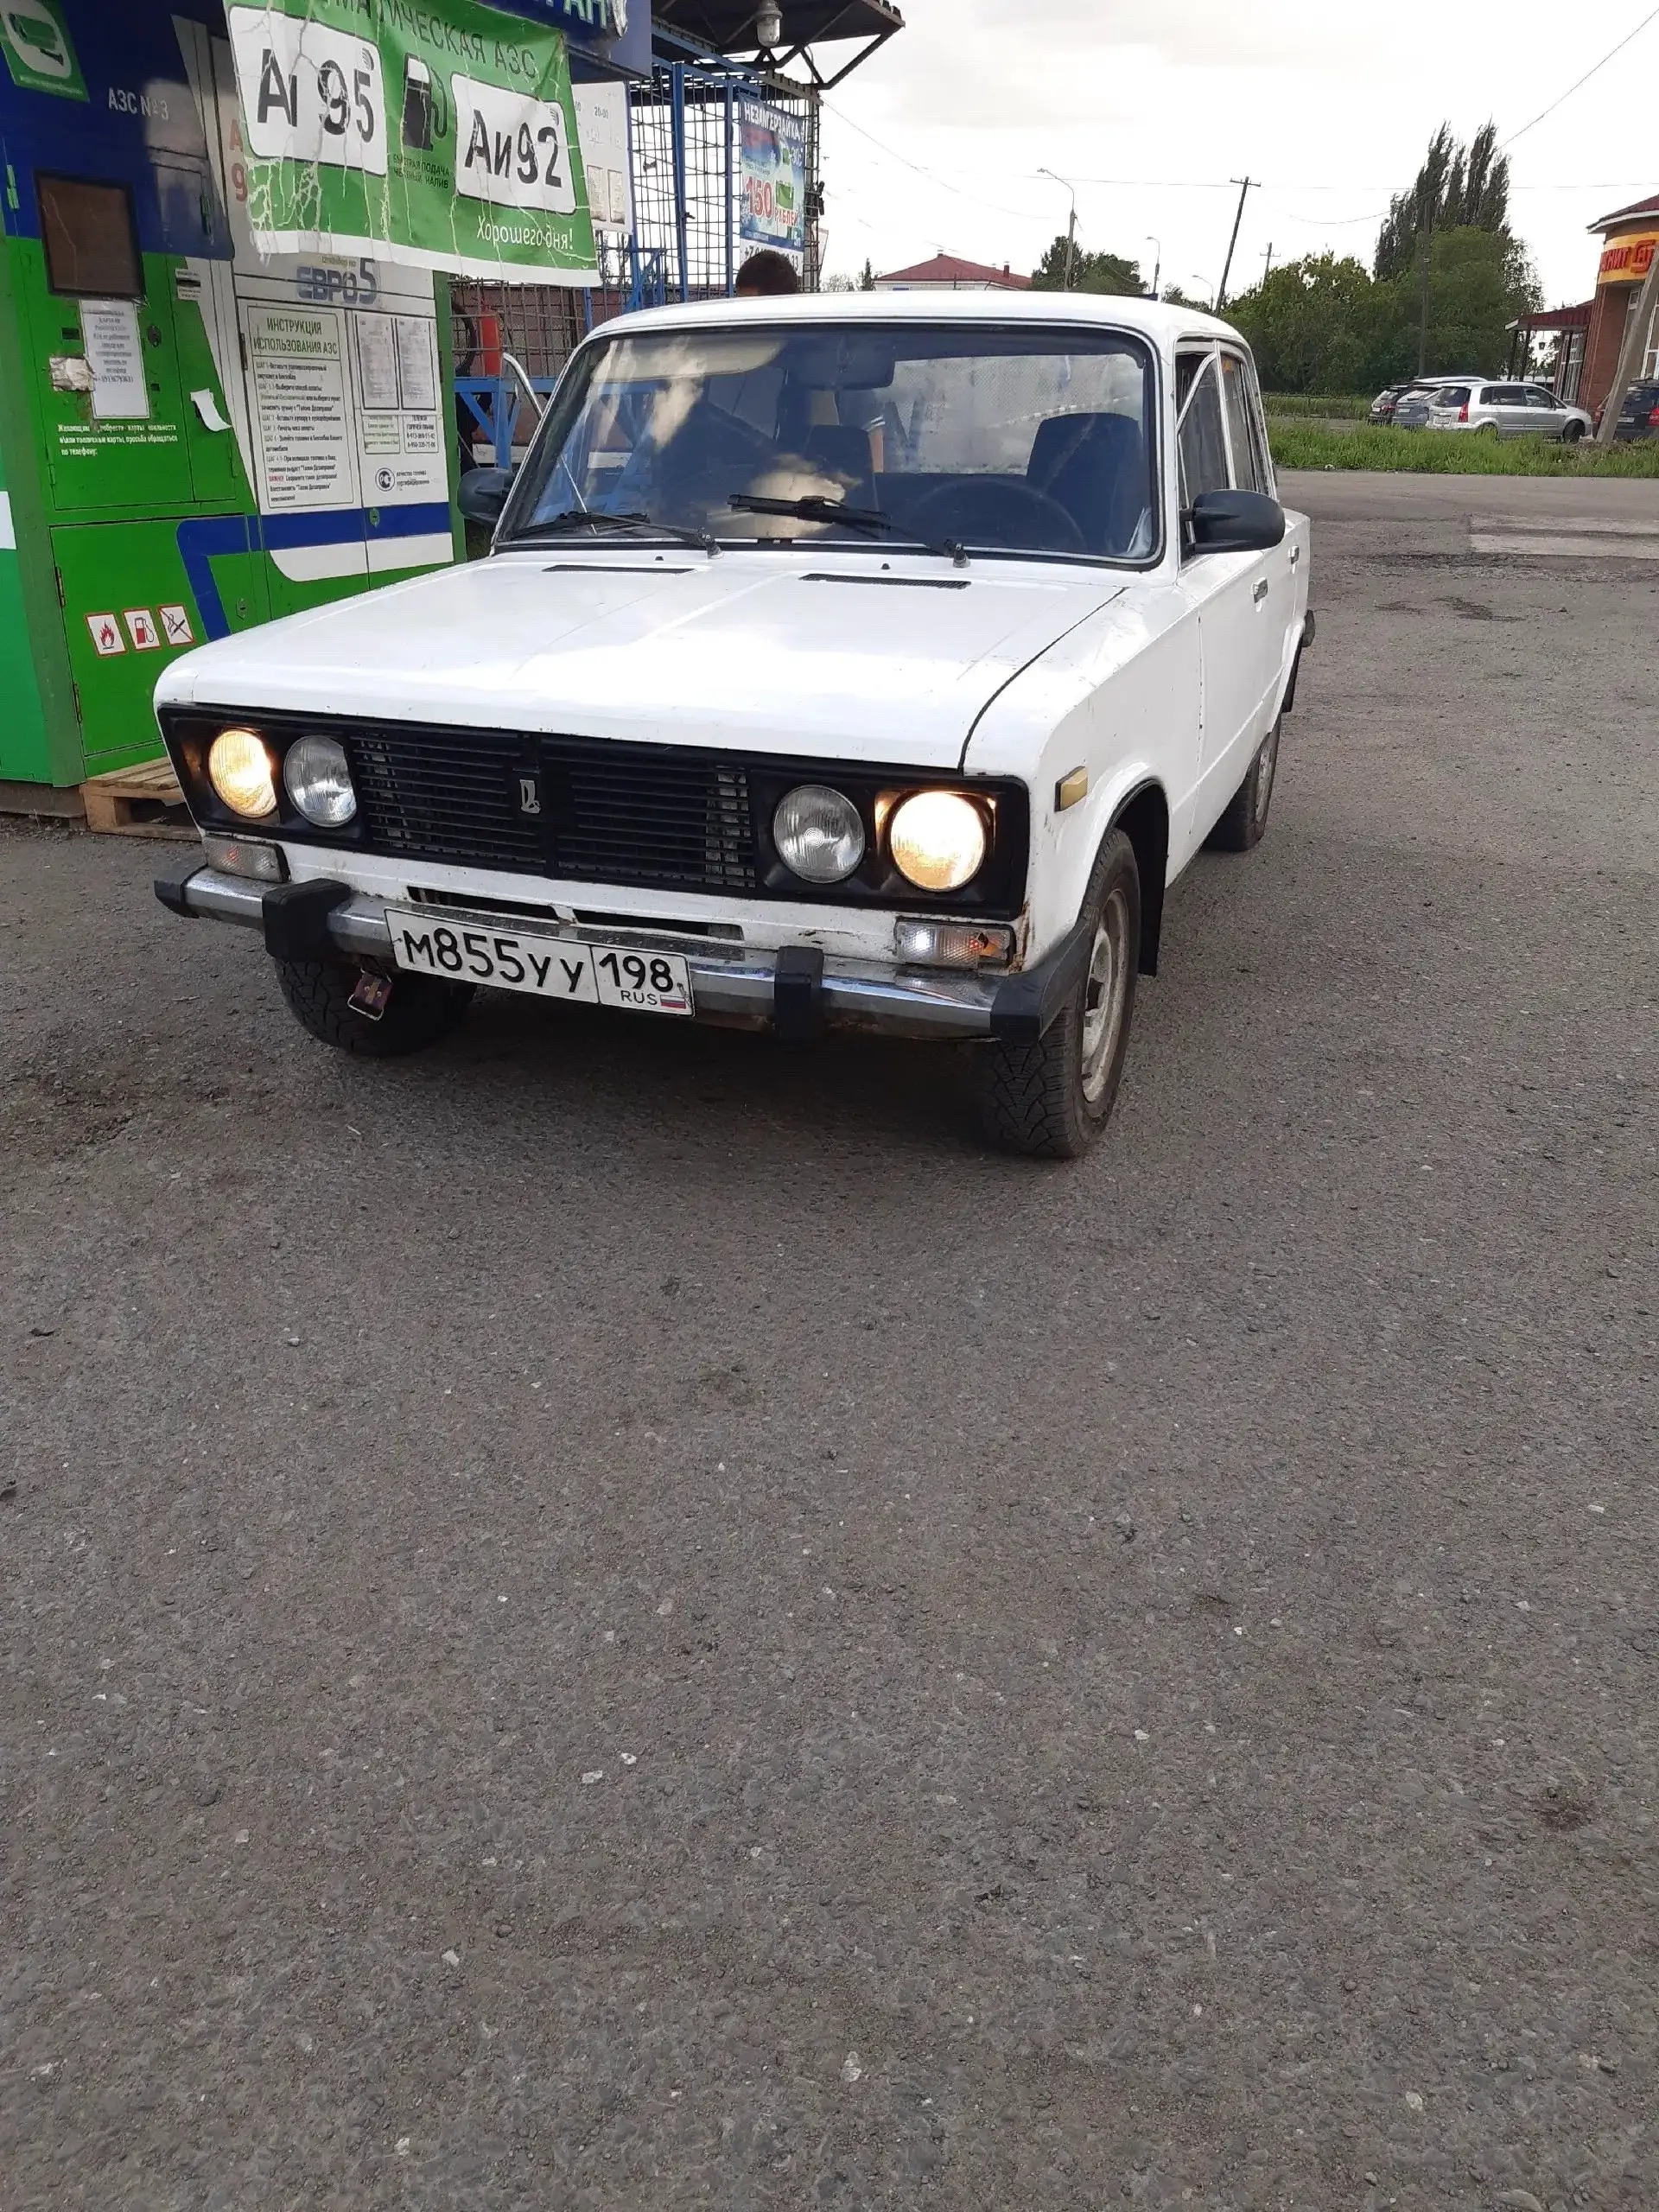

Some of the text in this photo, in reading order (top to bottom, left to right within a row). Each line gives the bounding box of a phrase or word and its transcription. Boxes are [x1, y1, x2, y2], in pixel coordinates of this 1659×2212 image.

[494, 41, 537, 79] АЗС
[108, 87, 137, 114] АЗС
[422, 162, 449, 176] ПОДАЧА
[426, 175, 449, 189] НАЛИВ
[746, 175, 772, 219] 150
[477, 215, 574, 250] Хорошего дня!
[266, 317, 322, 336] ИНСТРУКЦИЯ
[253, 336, 338, 354] ИСПОЛЬЗОВАНИЯ АЗС
[599, 952, 675, 993] 198
[620, 989, 658, 1006] RUS
